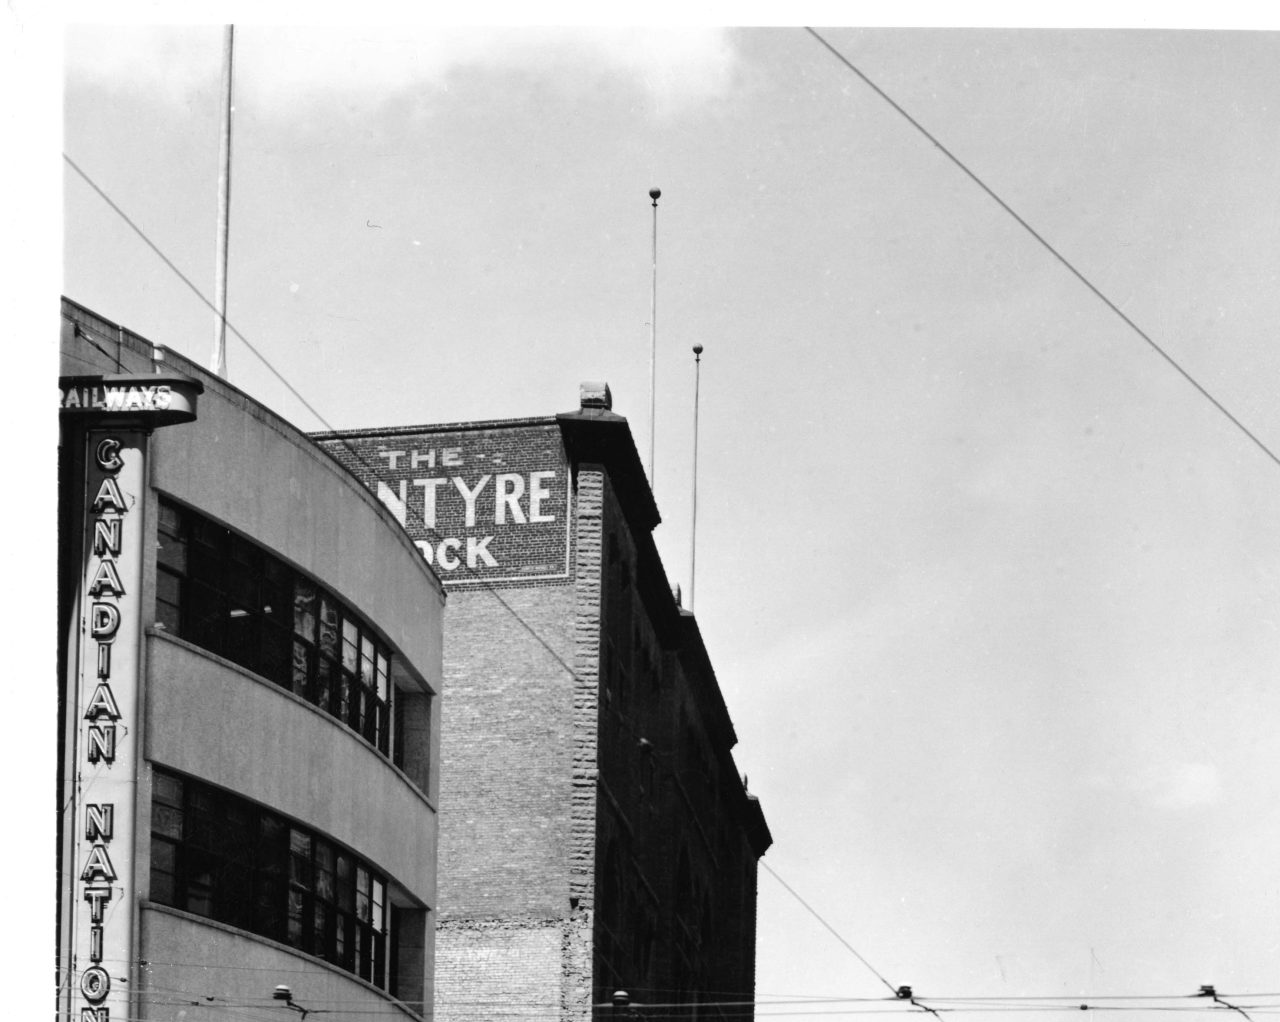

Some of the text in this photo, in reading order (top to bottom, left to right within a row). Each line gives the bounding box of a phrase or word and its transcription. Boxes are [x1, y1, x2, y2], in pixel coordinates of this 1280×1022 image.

[379, 447, 464, 470] THE
[366, 471, 556, 529] NTYRE
[84, 438, 127, 764] CANADIAN
